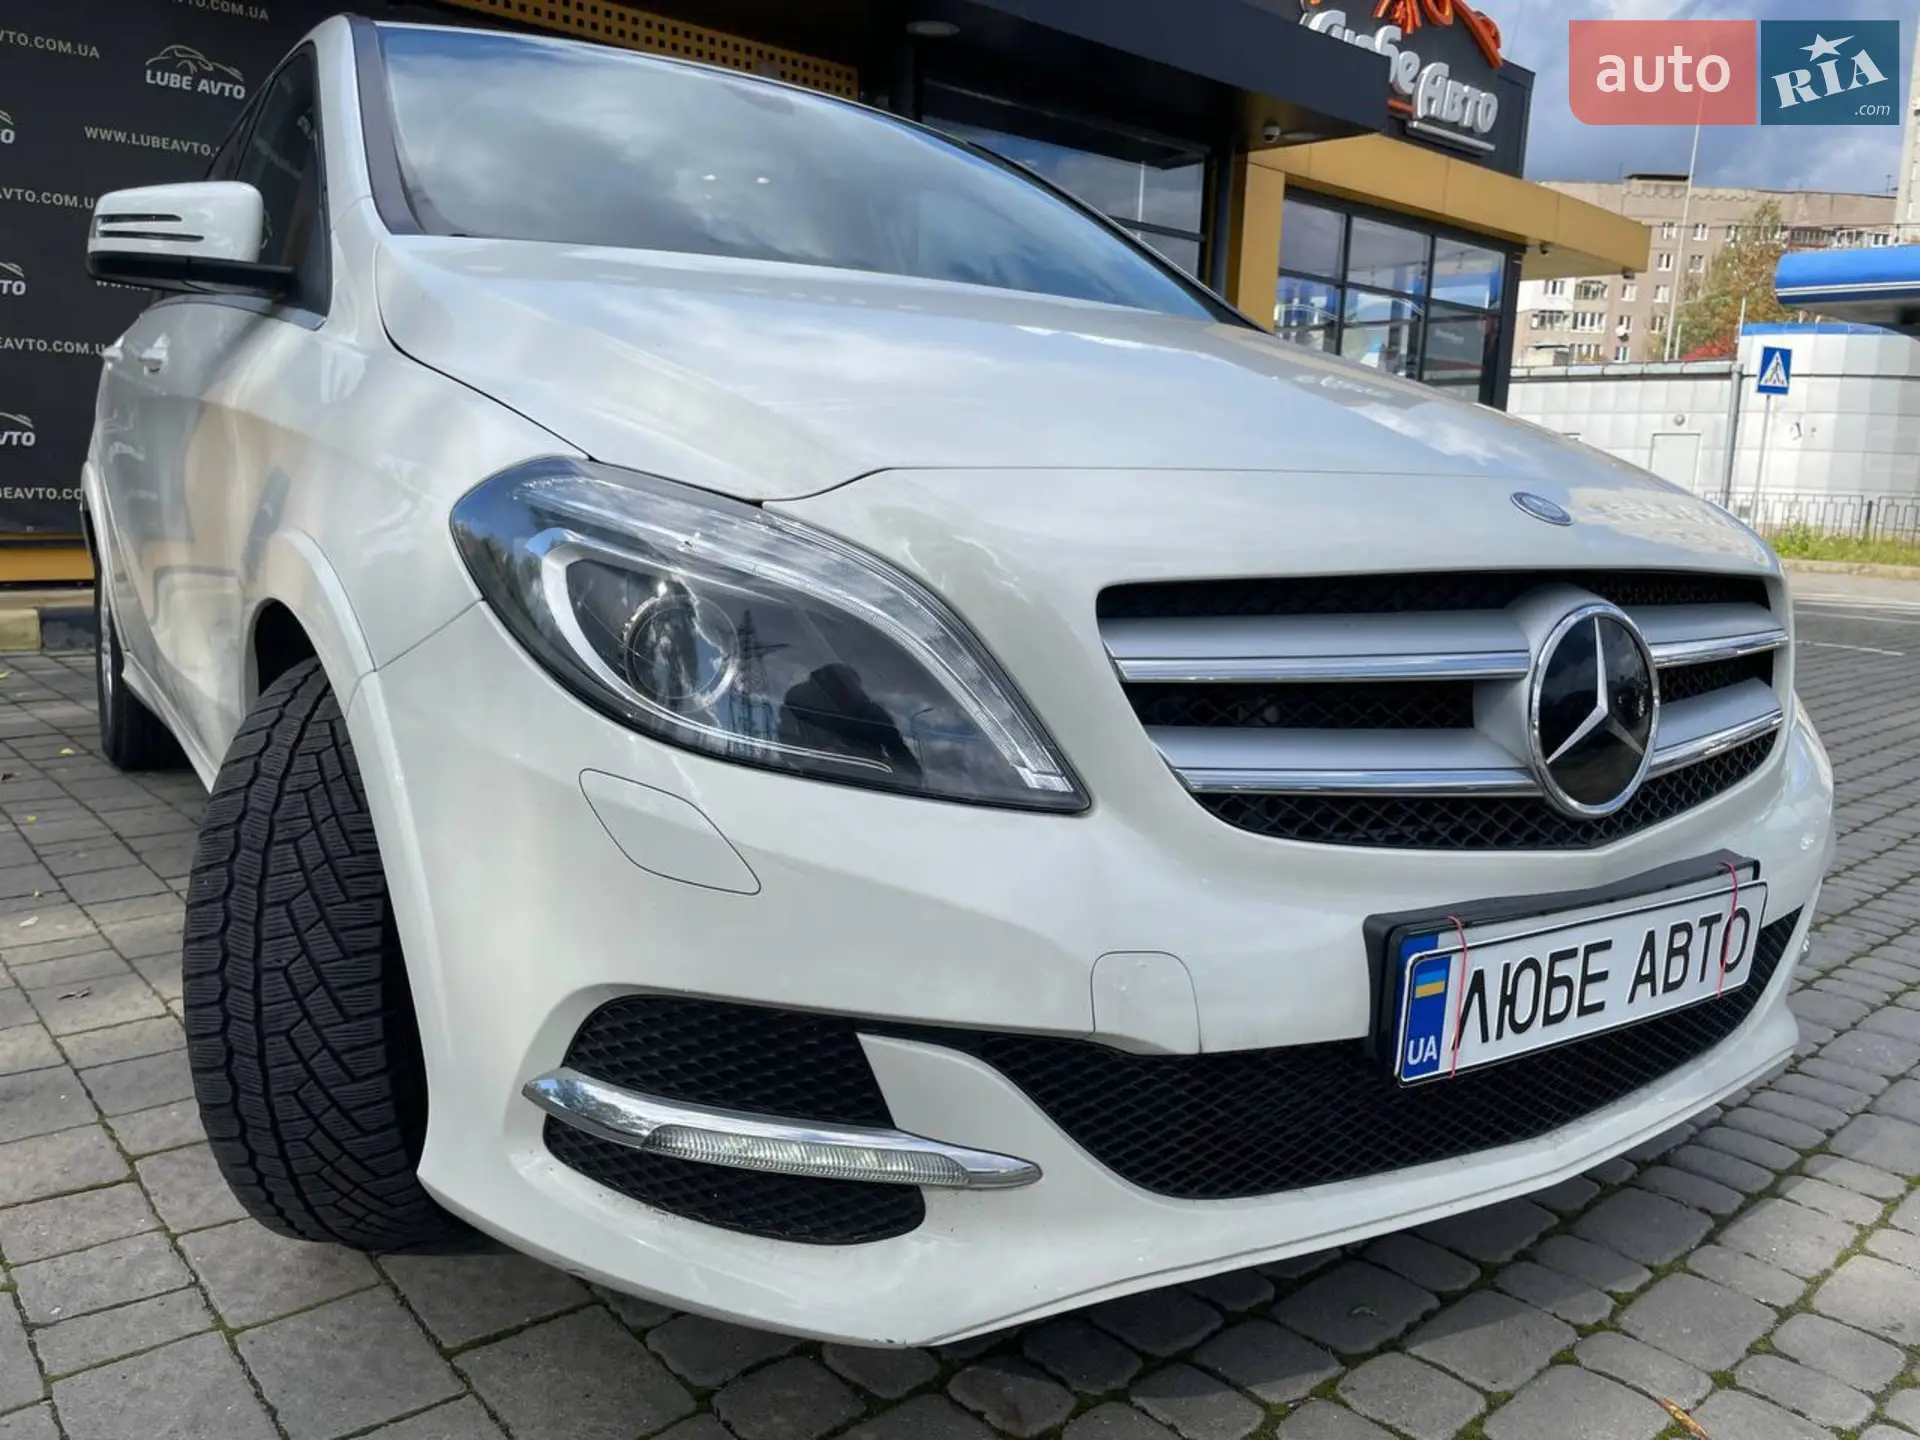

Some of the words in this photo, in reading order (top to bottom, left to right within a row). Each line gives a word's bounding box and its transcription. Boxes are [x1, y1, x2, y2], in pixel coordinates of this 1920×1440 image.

[145, 69, 193, 91] LUBE
[197, 78, 246, 99] AVTO
[1451, 939, 1613, 1052] ЛЮБЕ
[1626, 906, 1751, 1004] АВТО
[1407, 1034, 1438, 1066] UA
